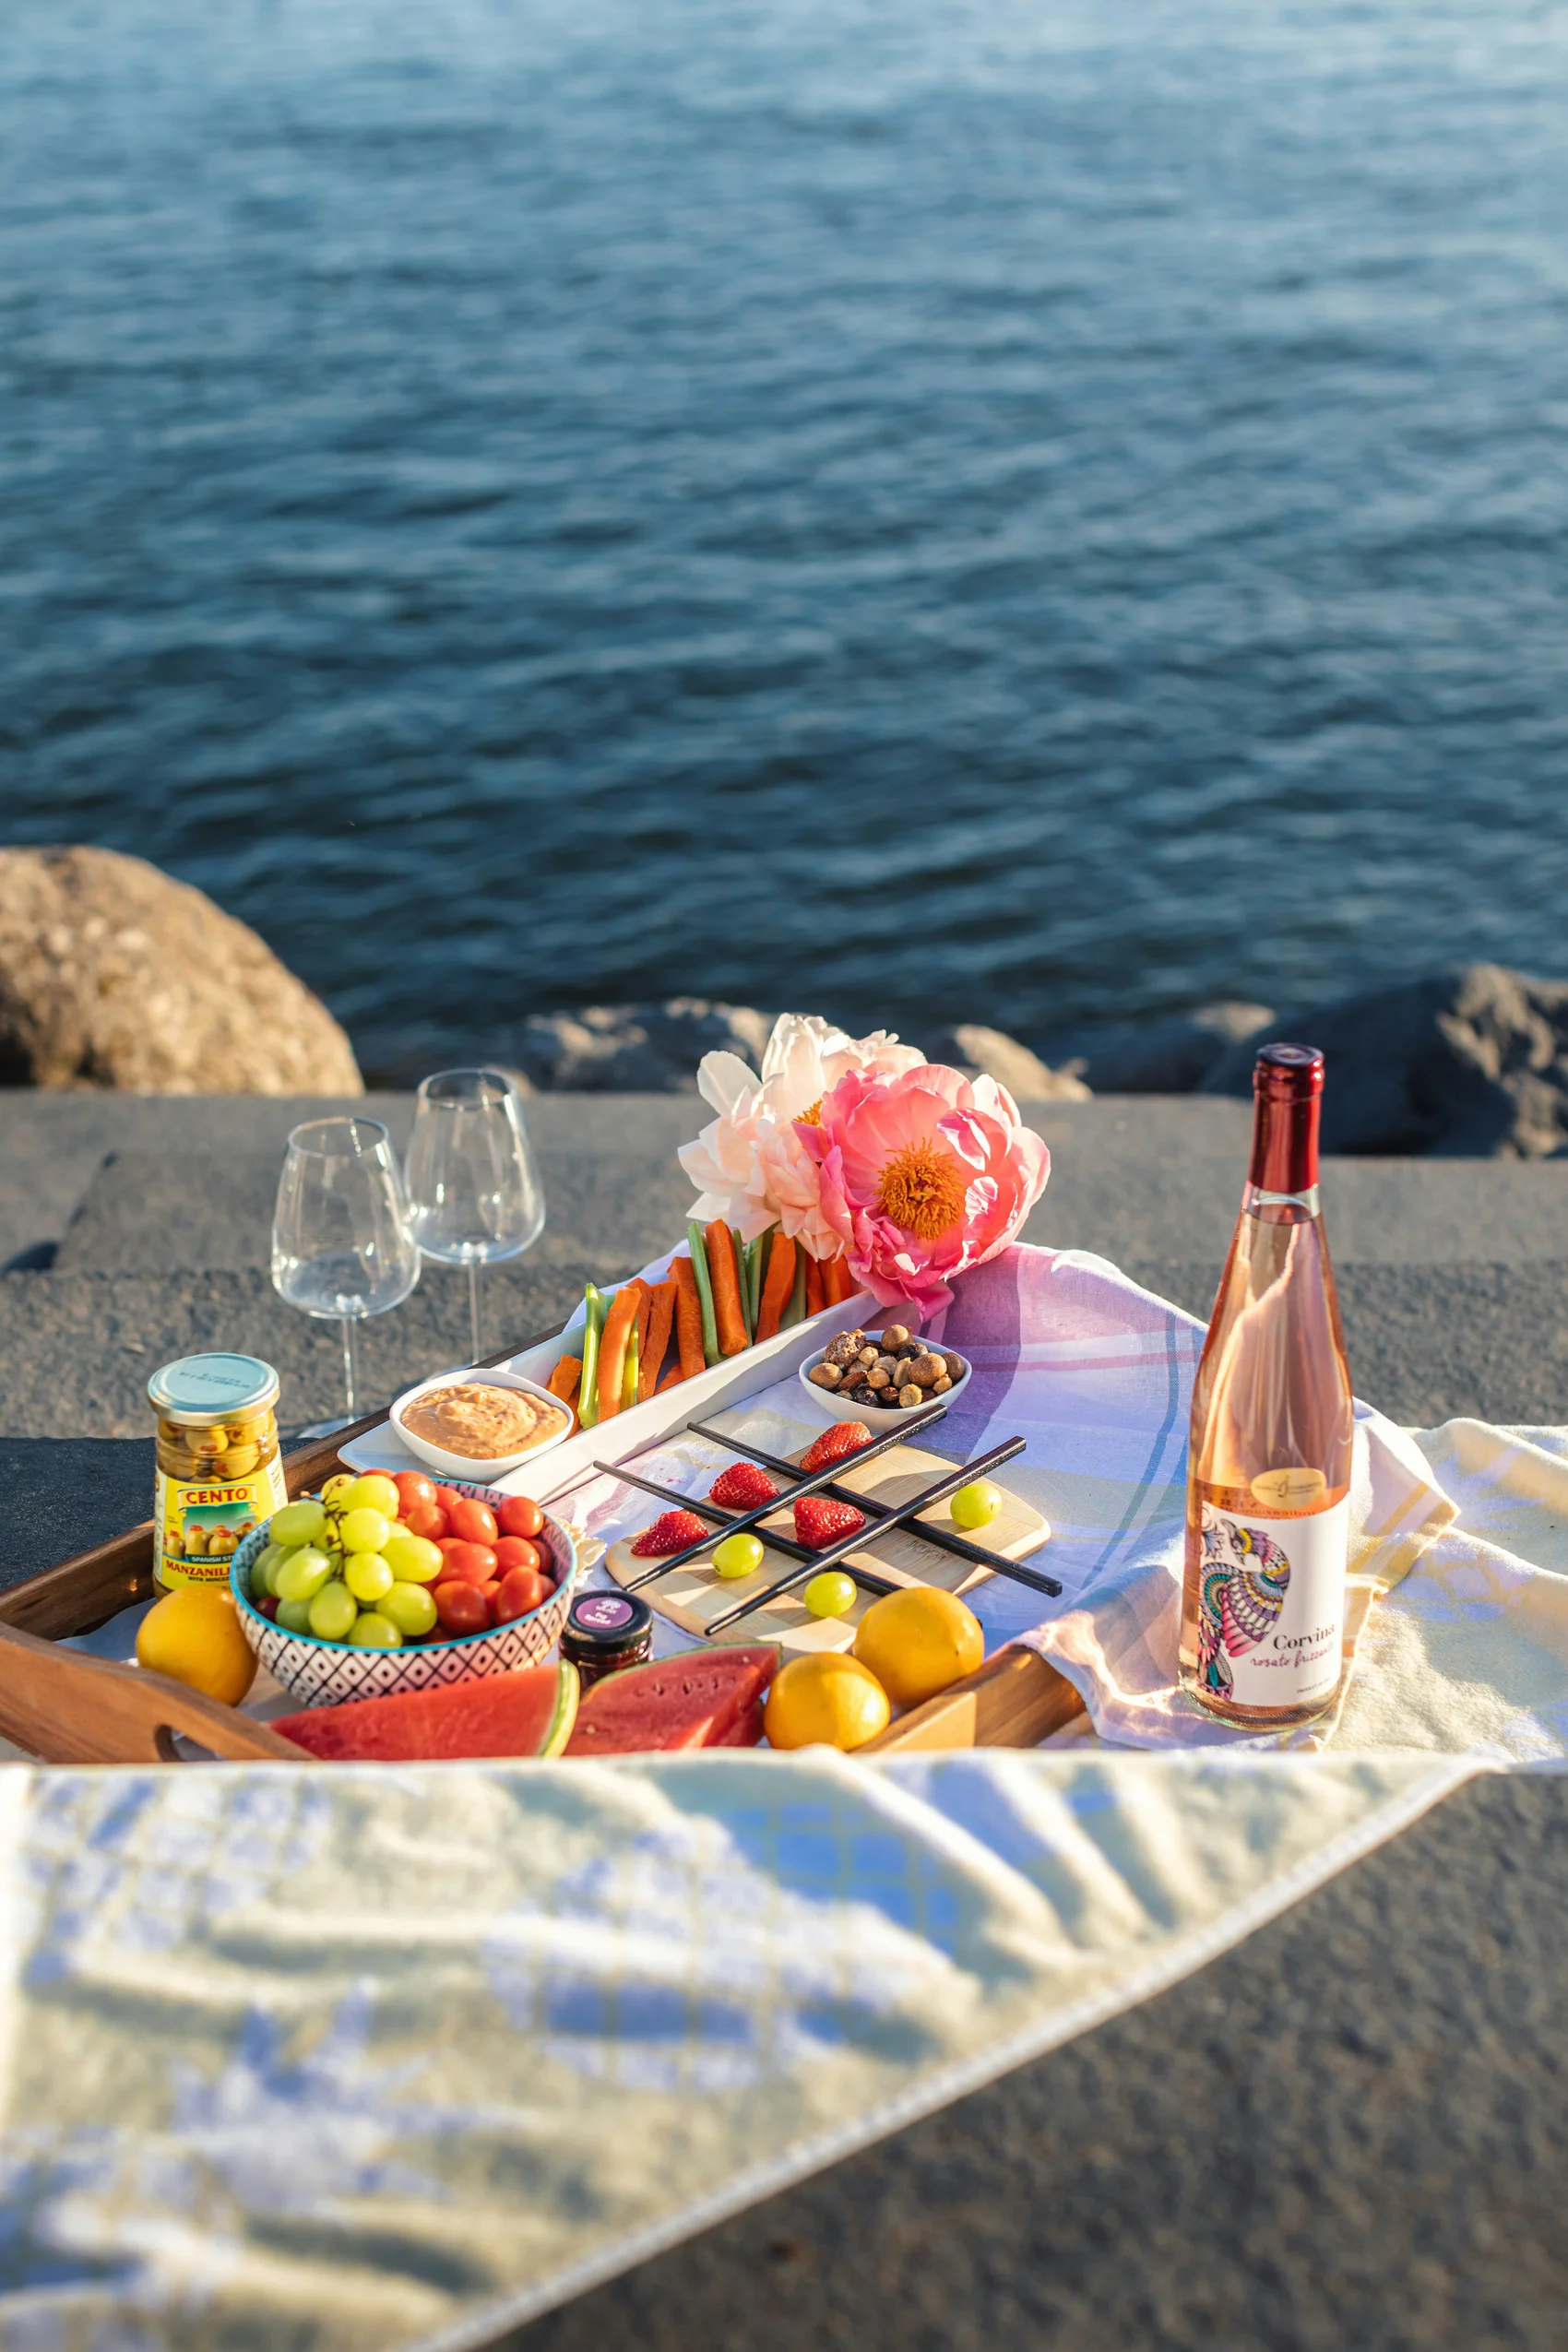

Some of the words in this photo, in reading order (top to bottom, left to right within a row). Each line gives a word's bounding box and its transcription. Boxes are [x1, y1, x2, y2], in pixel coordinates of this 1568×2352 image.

[186, 1487, 248, 1504] CENTO
[191, 1555, 221, 1563] SPANISH
[221, 1554, 233, 1562] ST
[1273, 1623, 1335, 1651] Corvina
[1250, 1653, 1291, 1668] rosato
[1294, 1642, 1334, 1669] frizzan
